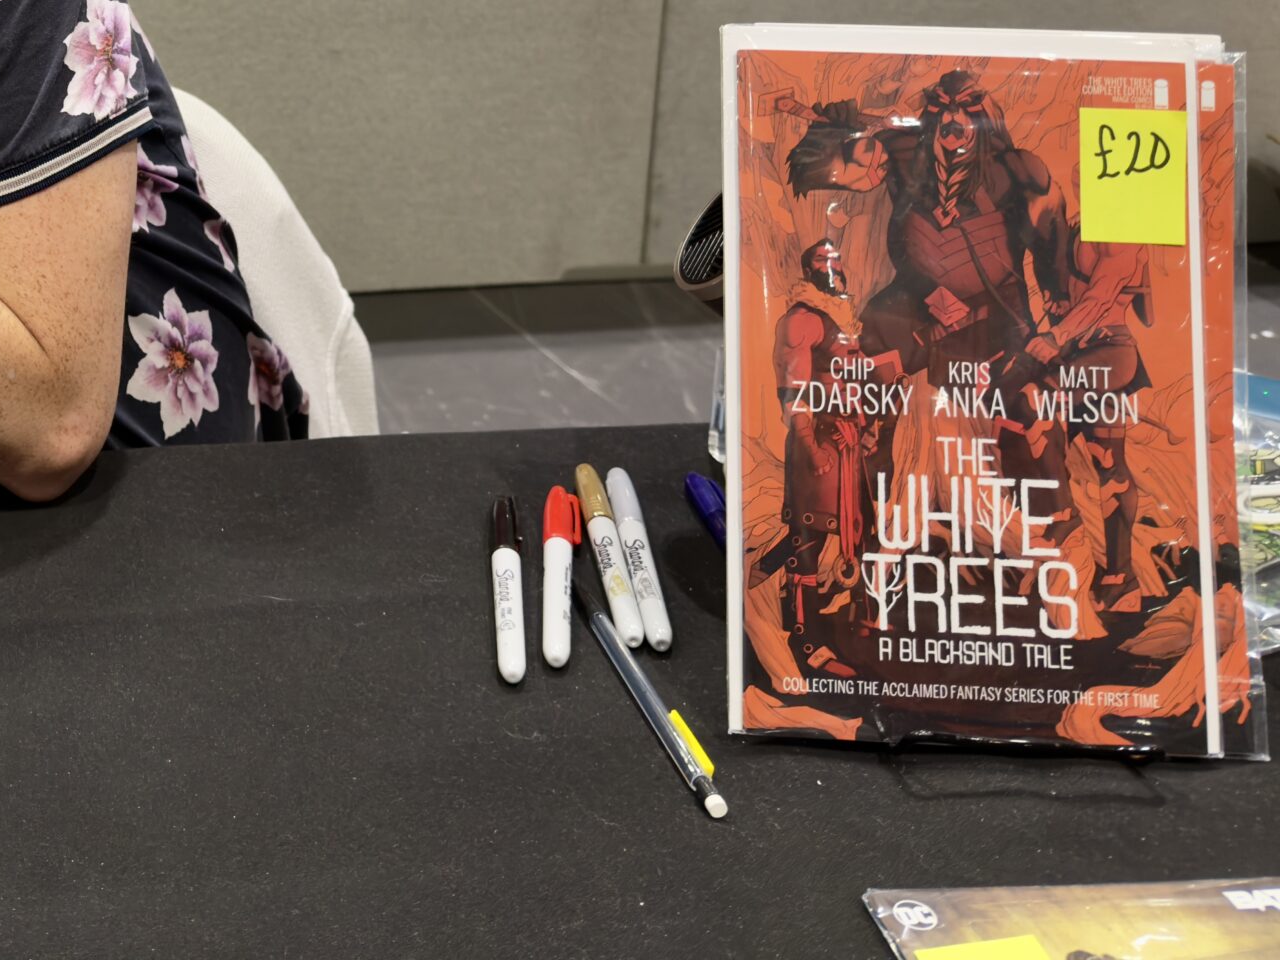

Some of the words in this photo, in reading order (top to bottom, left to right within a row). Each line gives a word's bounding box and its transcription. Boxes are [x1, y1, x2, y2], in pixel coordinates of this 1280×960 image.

[1094, 124, 1171, 180] £20
[829, 356, 875, 381] CHIP
[948, 361, 992, 386] KRIS
[1059, 366, 1112, 390] MATT
[791, 380, 913, 416] ZDARSKY
[933, 387, 1007, 420] ANKA
[1033, 390, 1139, 425] WILSON
[936, 436, 998, 476] THE
[877, 472, 1061, 557] WHITE
[594, 535, 616, 571] Sharpie
[624, 538, 649, 573] Sharpie
[861, 553, 1079, 640] TREES
[879, 637, 893, 662] A
[899, 638, 1015, 667] BLACKSAND
[1021, 643, 1075, 670] TALE
[782, 676, 855, 695] COLLECTING
[857, 680, 880, 696] THE
[882, 682, 948, 699] ACCLAIMED
[950, 685, 1002, 702] FANTASY
[1004, 687, 1045, 704] SERIES
[1047, 689, 1070, 705] FOR
[1072, 690, 1095, 706] THE
[1097, 691, 1129, 707] FIRST
[1132, 692, 1161, 709] TIME
